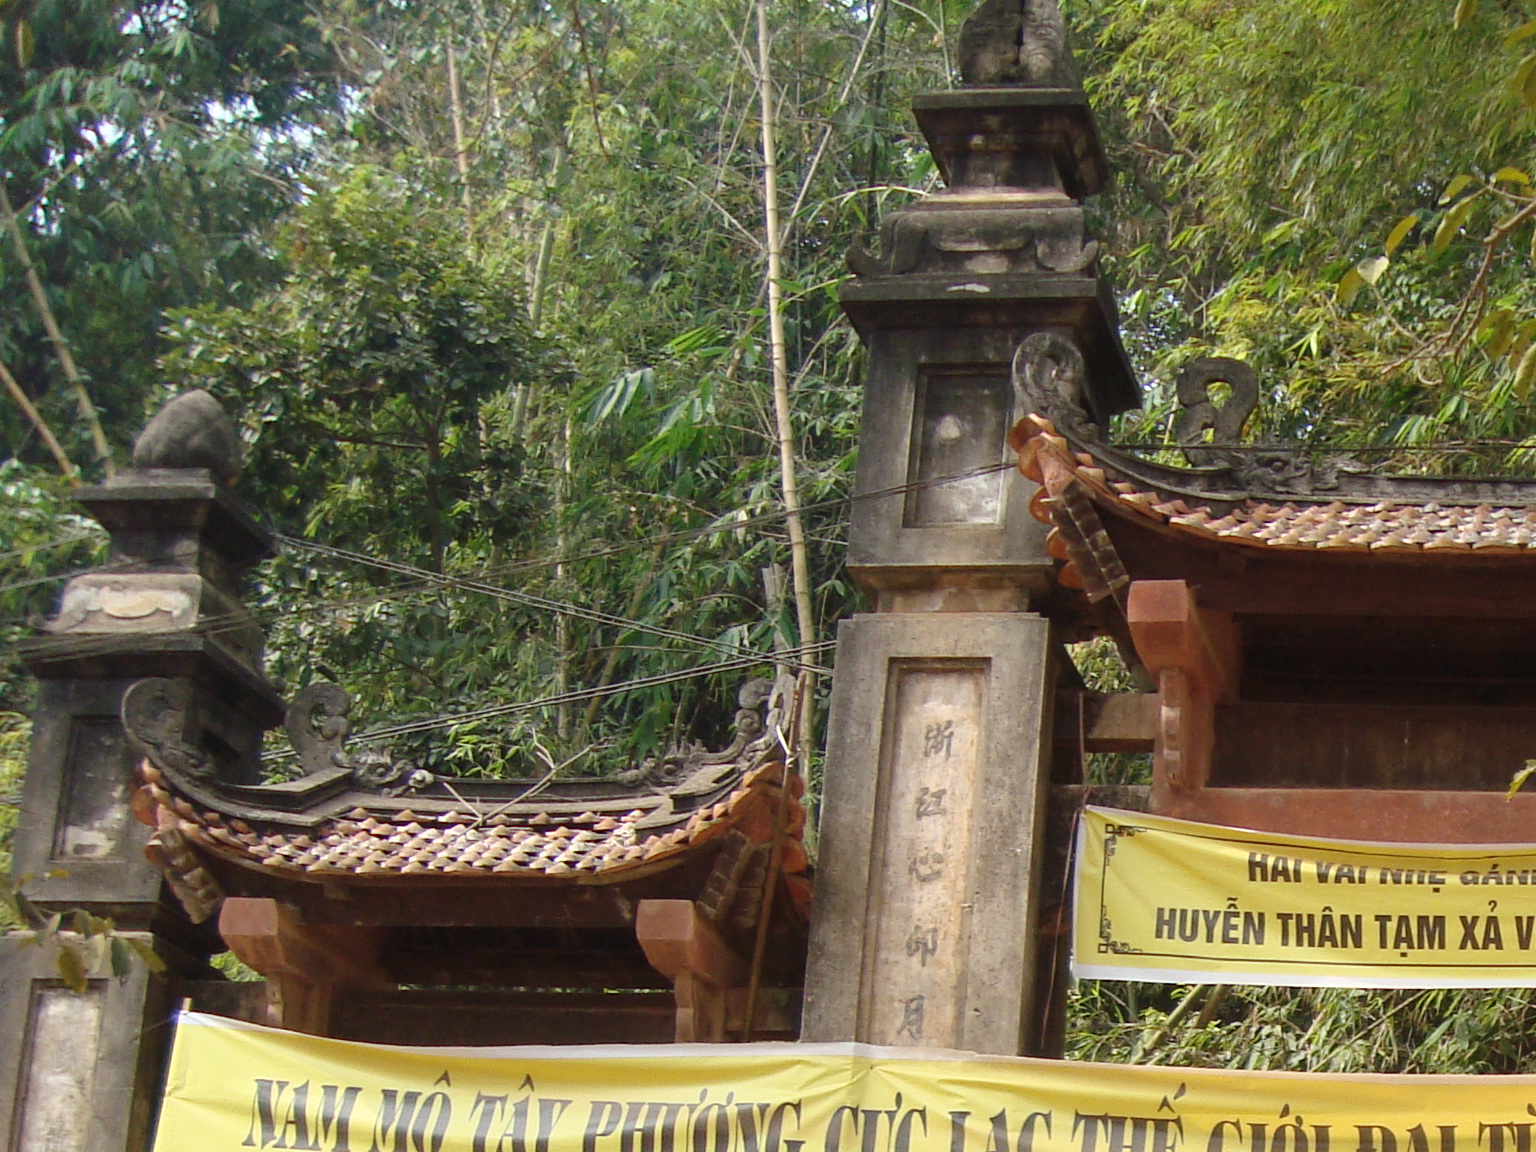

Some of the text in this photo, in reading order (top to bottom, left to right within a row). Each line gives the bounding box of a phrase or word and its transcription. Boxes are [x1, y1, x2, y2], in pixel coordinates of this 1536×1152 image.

[1248, 851, 1303, 884] HAI
[1154, 893, 1267, 947] HUYỄN
[1276, 905, 1363, 949] THÂN
[1374, 914, 1447, 958] TẠM
[1458, 900, 1504, 951] XẢ
